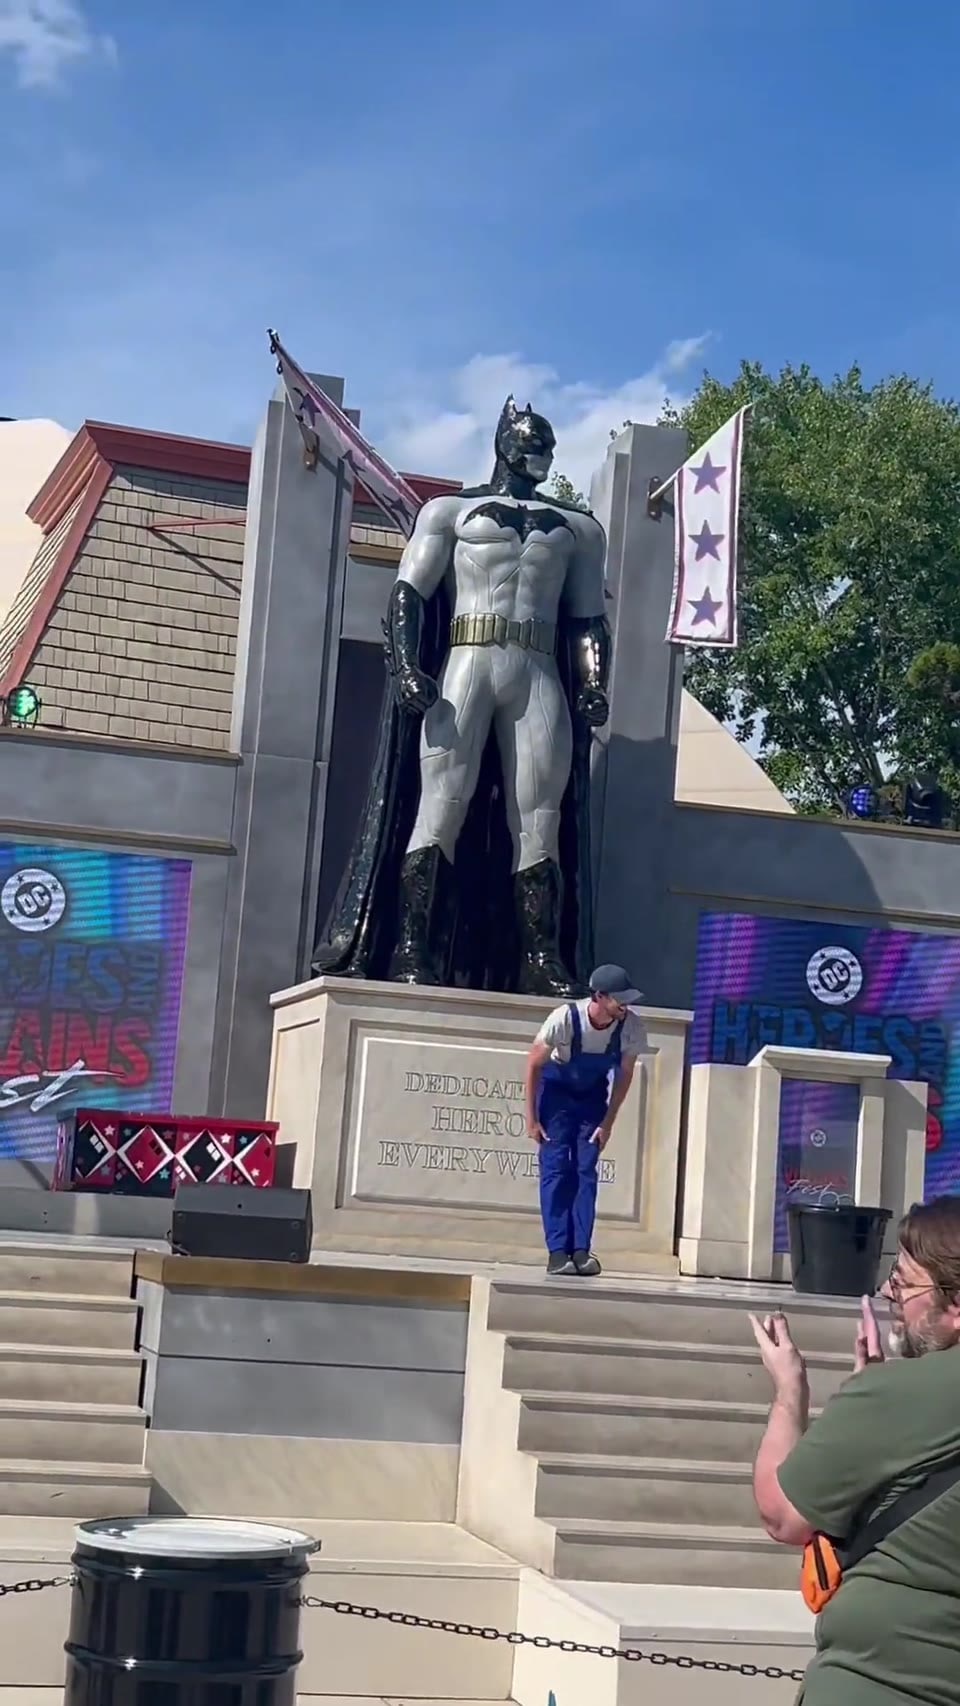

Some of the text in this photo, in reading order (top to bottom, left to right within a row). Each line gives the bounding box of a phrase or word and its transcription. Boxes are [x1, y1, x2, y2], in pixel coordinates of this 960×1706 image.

[404, 1070, 528, 1101] DEDICAT
[431, 1105, 529, 1138] HERO
[377, 1140, 617, 1184] EVERYWHE
